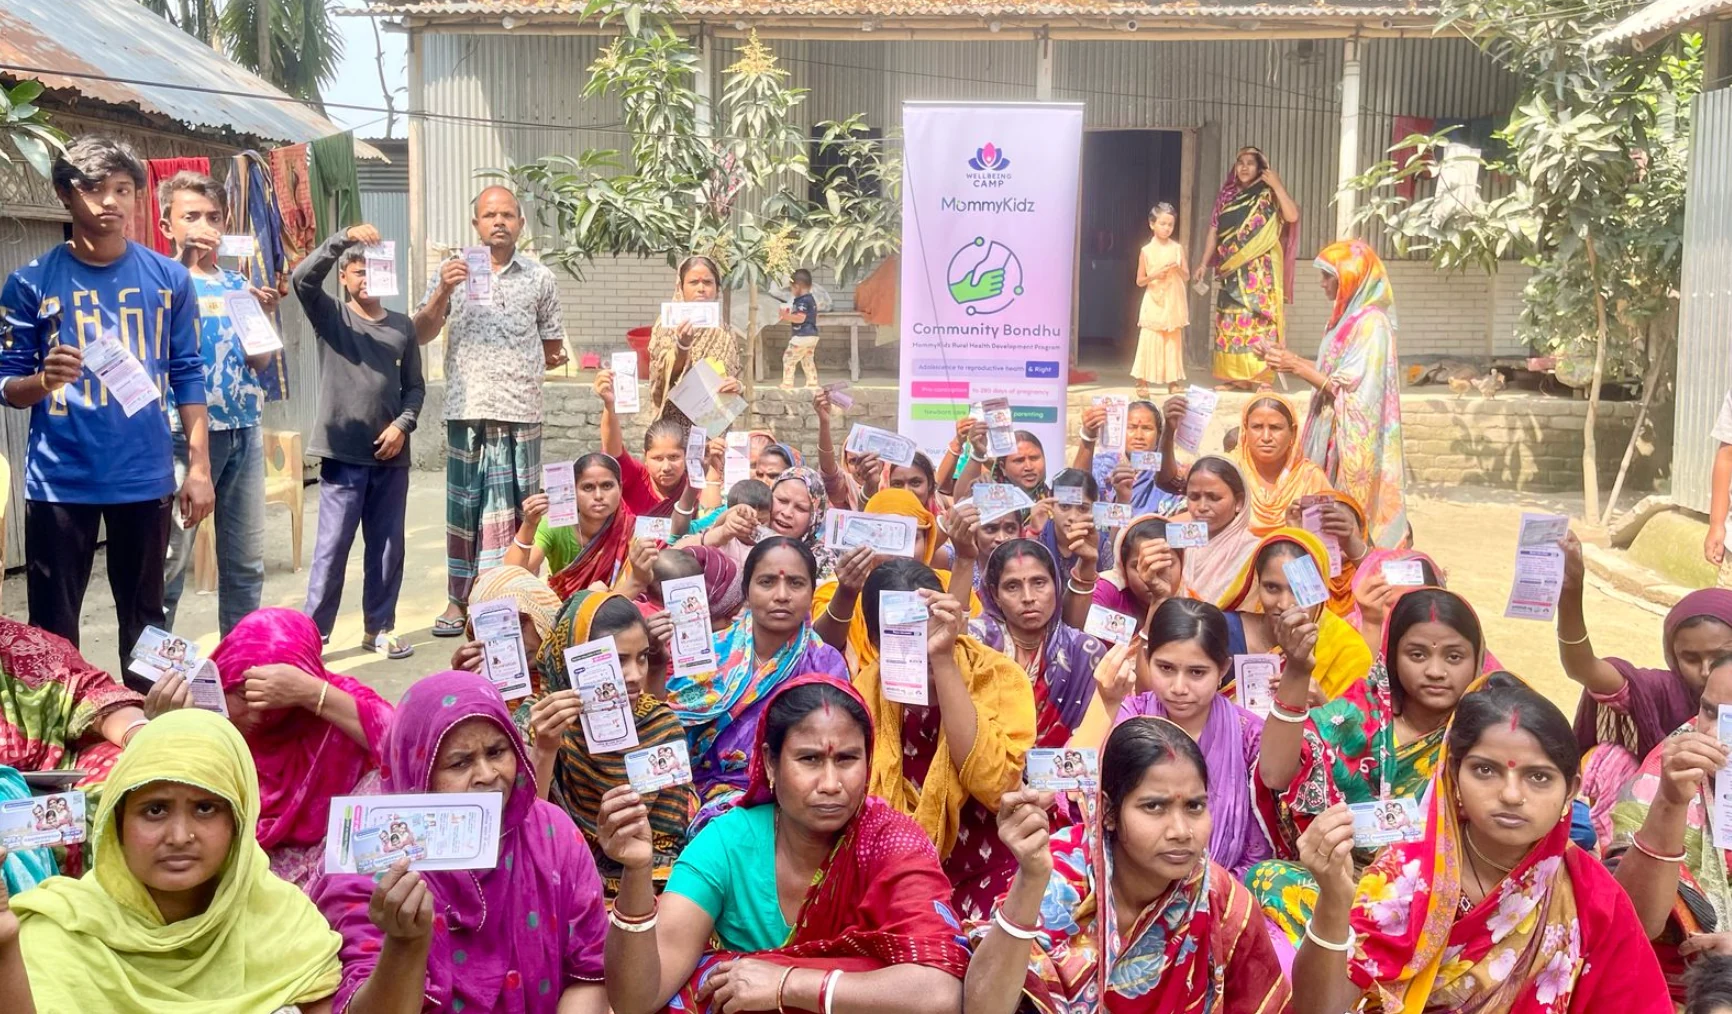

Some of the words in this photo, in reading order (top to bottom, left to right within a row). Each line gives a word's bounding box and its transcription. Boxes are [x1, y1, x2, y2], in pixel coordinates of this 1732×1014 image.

[973, 180, 1004, 188] CAMP
[941, 197, 1035, 214] MommyKidz
[912, 322, 1000, 339] Community
[1003, 324, 1061, 337] Bondhu
[991, 343, 1034, 351] Development
[1034, 344, 1060, 352] Program
[965, 364, 1004, 372] reproductive
[1034, 366, 1052, 374] Right
[1013, 411, 1044, 419] parenting
